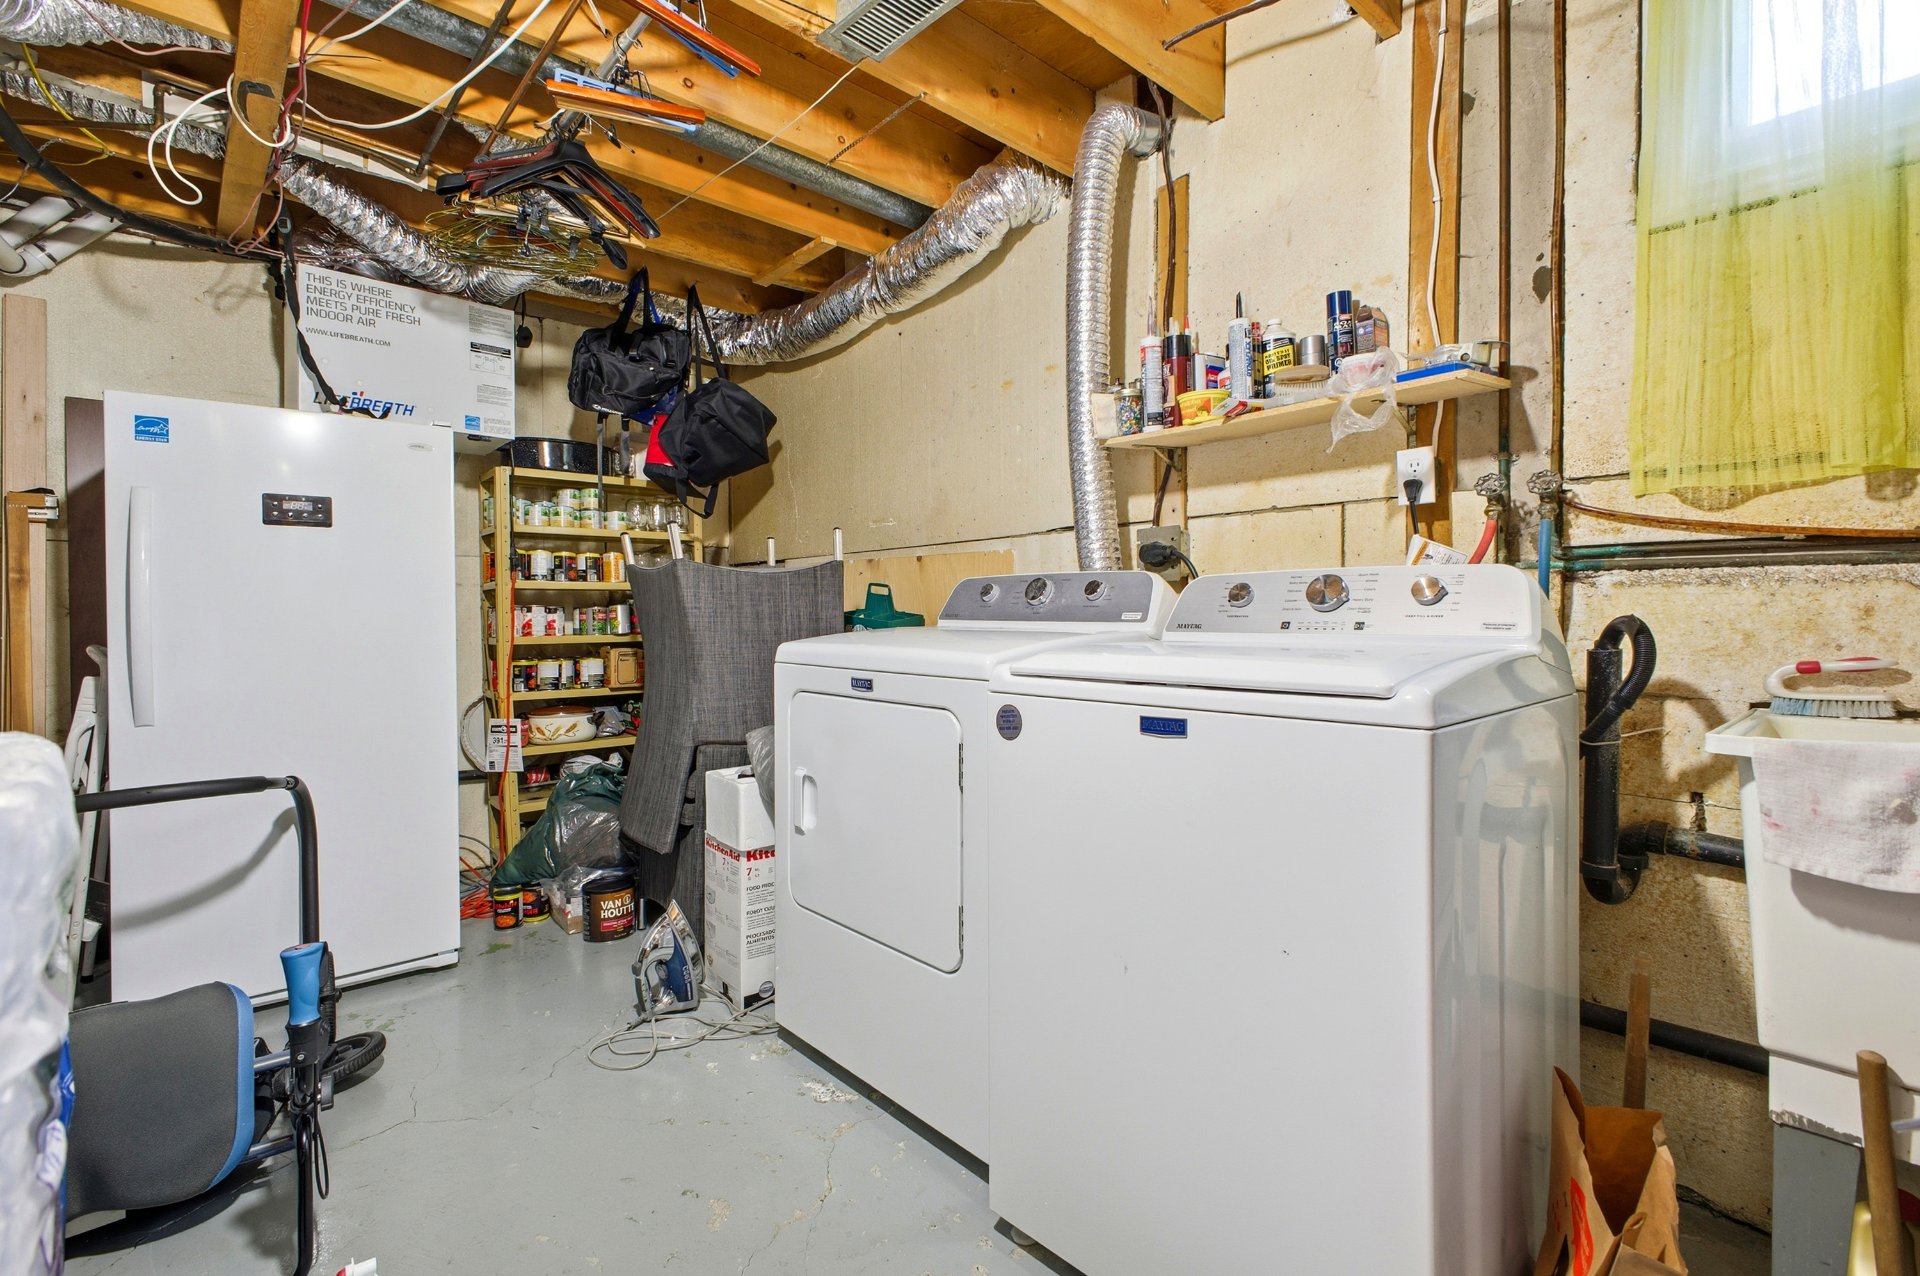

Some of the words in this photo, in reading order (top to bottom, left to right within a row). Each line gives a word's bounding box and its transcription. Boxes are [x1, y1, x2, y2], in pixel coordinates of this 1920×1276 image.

[306, 272, 332, 286] THIS
[336, 279, 347, 289] IS
[350, 281, 393, 299] WHERE
[306, 284, 353, 300] ENERGY
[356, 293, 416, 314] EFFICIENCY
[306, 295, 348, 311] MEETS
[351, 304, 382, 319] PURE
[385, 311, 421, 326] FRESH
[306, 306, 353, 324] INDOOR
[356, 316, 376, 328] AIR
[305, 327, 391, 347] WWW.LIFEBREATH.COM
[1142, 719, 1184, 732] MAYTAG
[746, 867, 752, 877] 7
[600, 898, 622, 910] VAN
